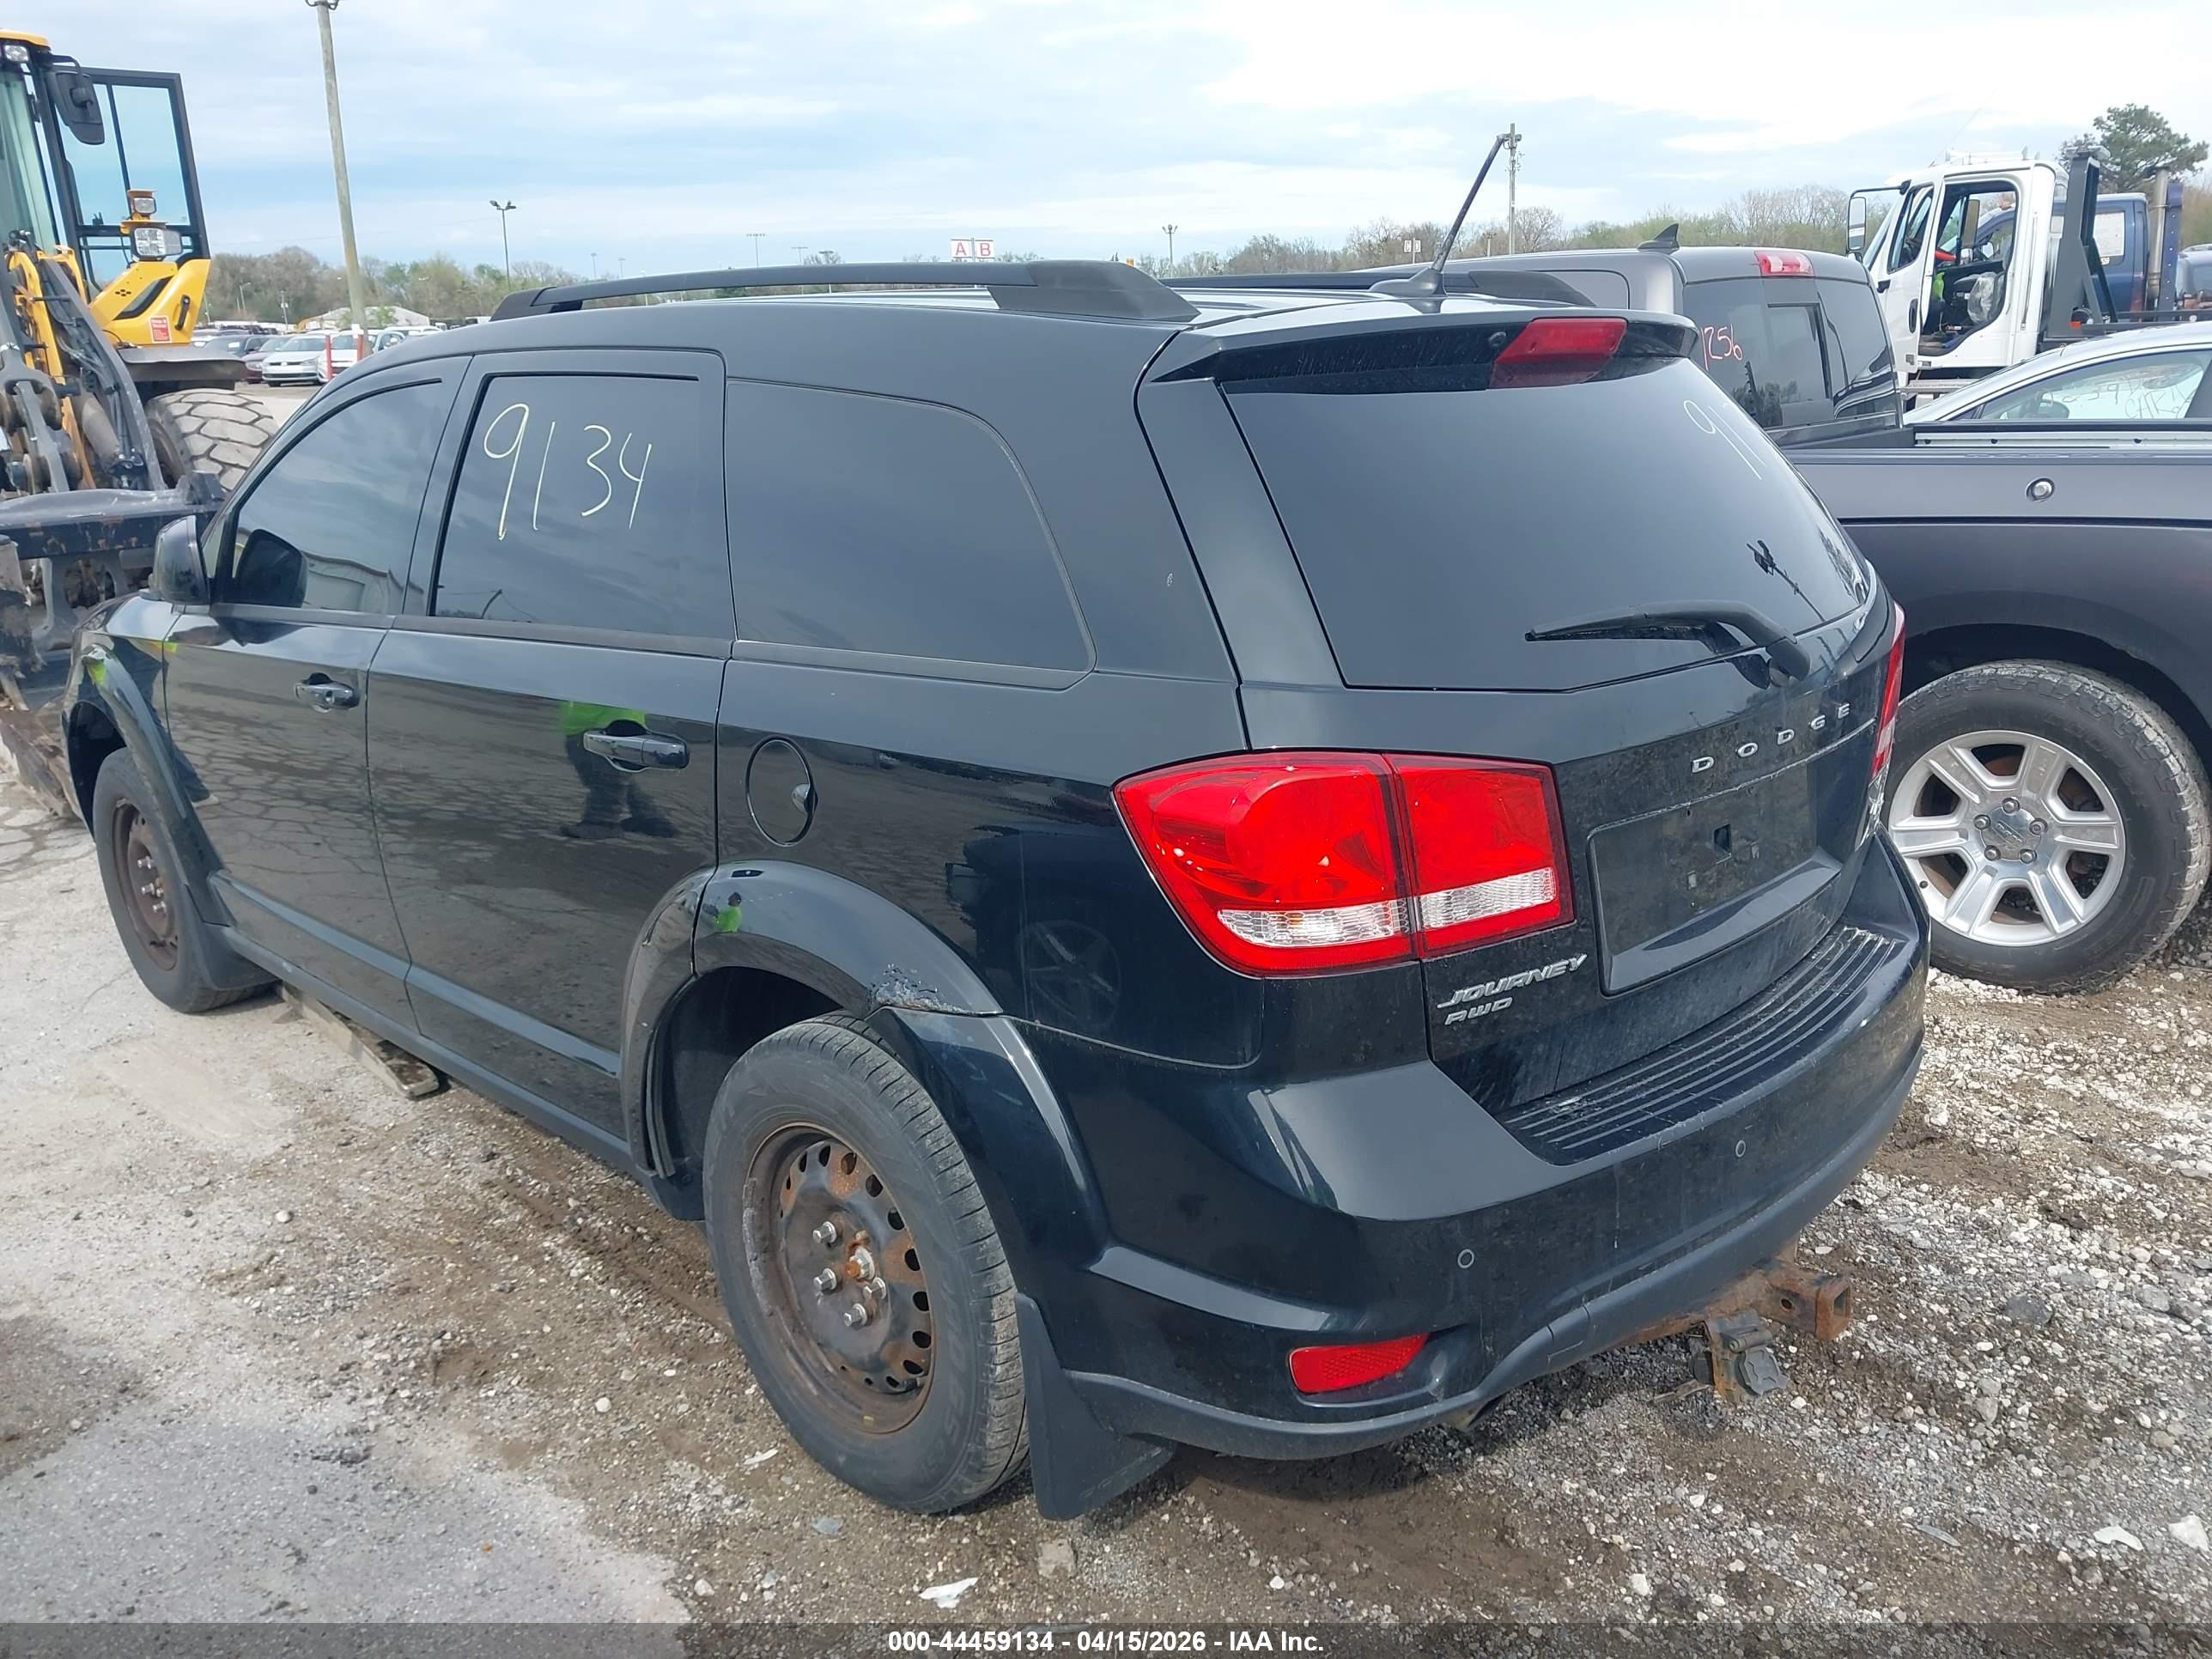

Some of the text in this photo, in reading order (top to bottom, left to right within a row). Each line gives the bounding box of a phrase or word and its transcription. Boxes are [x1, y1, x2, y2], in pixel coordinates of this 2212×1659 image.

[956, 241, 967, 256] A
[980, 242, 991, 257] B
[1700, 323, 1743, 371] 1256
[483, 403, 652, 540] 9134
[1692, 702, 1850, 773] DODGE
[1437, 953, 1588, 1009] JOURNEY
[1444, 996, 1513, 1025] AWD
